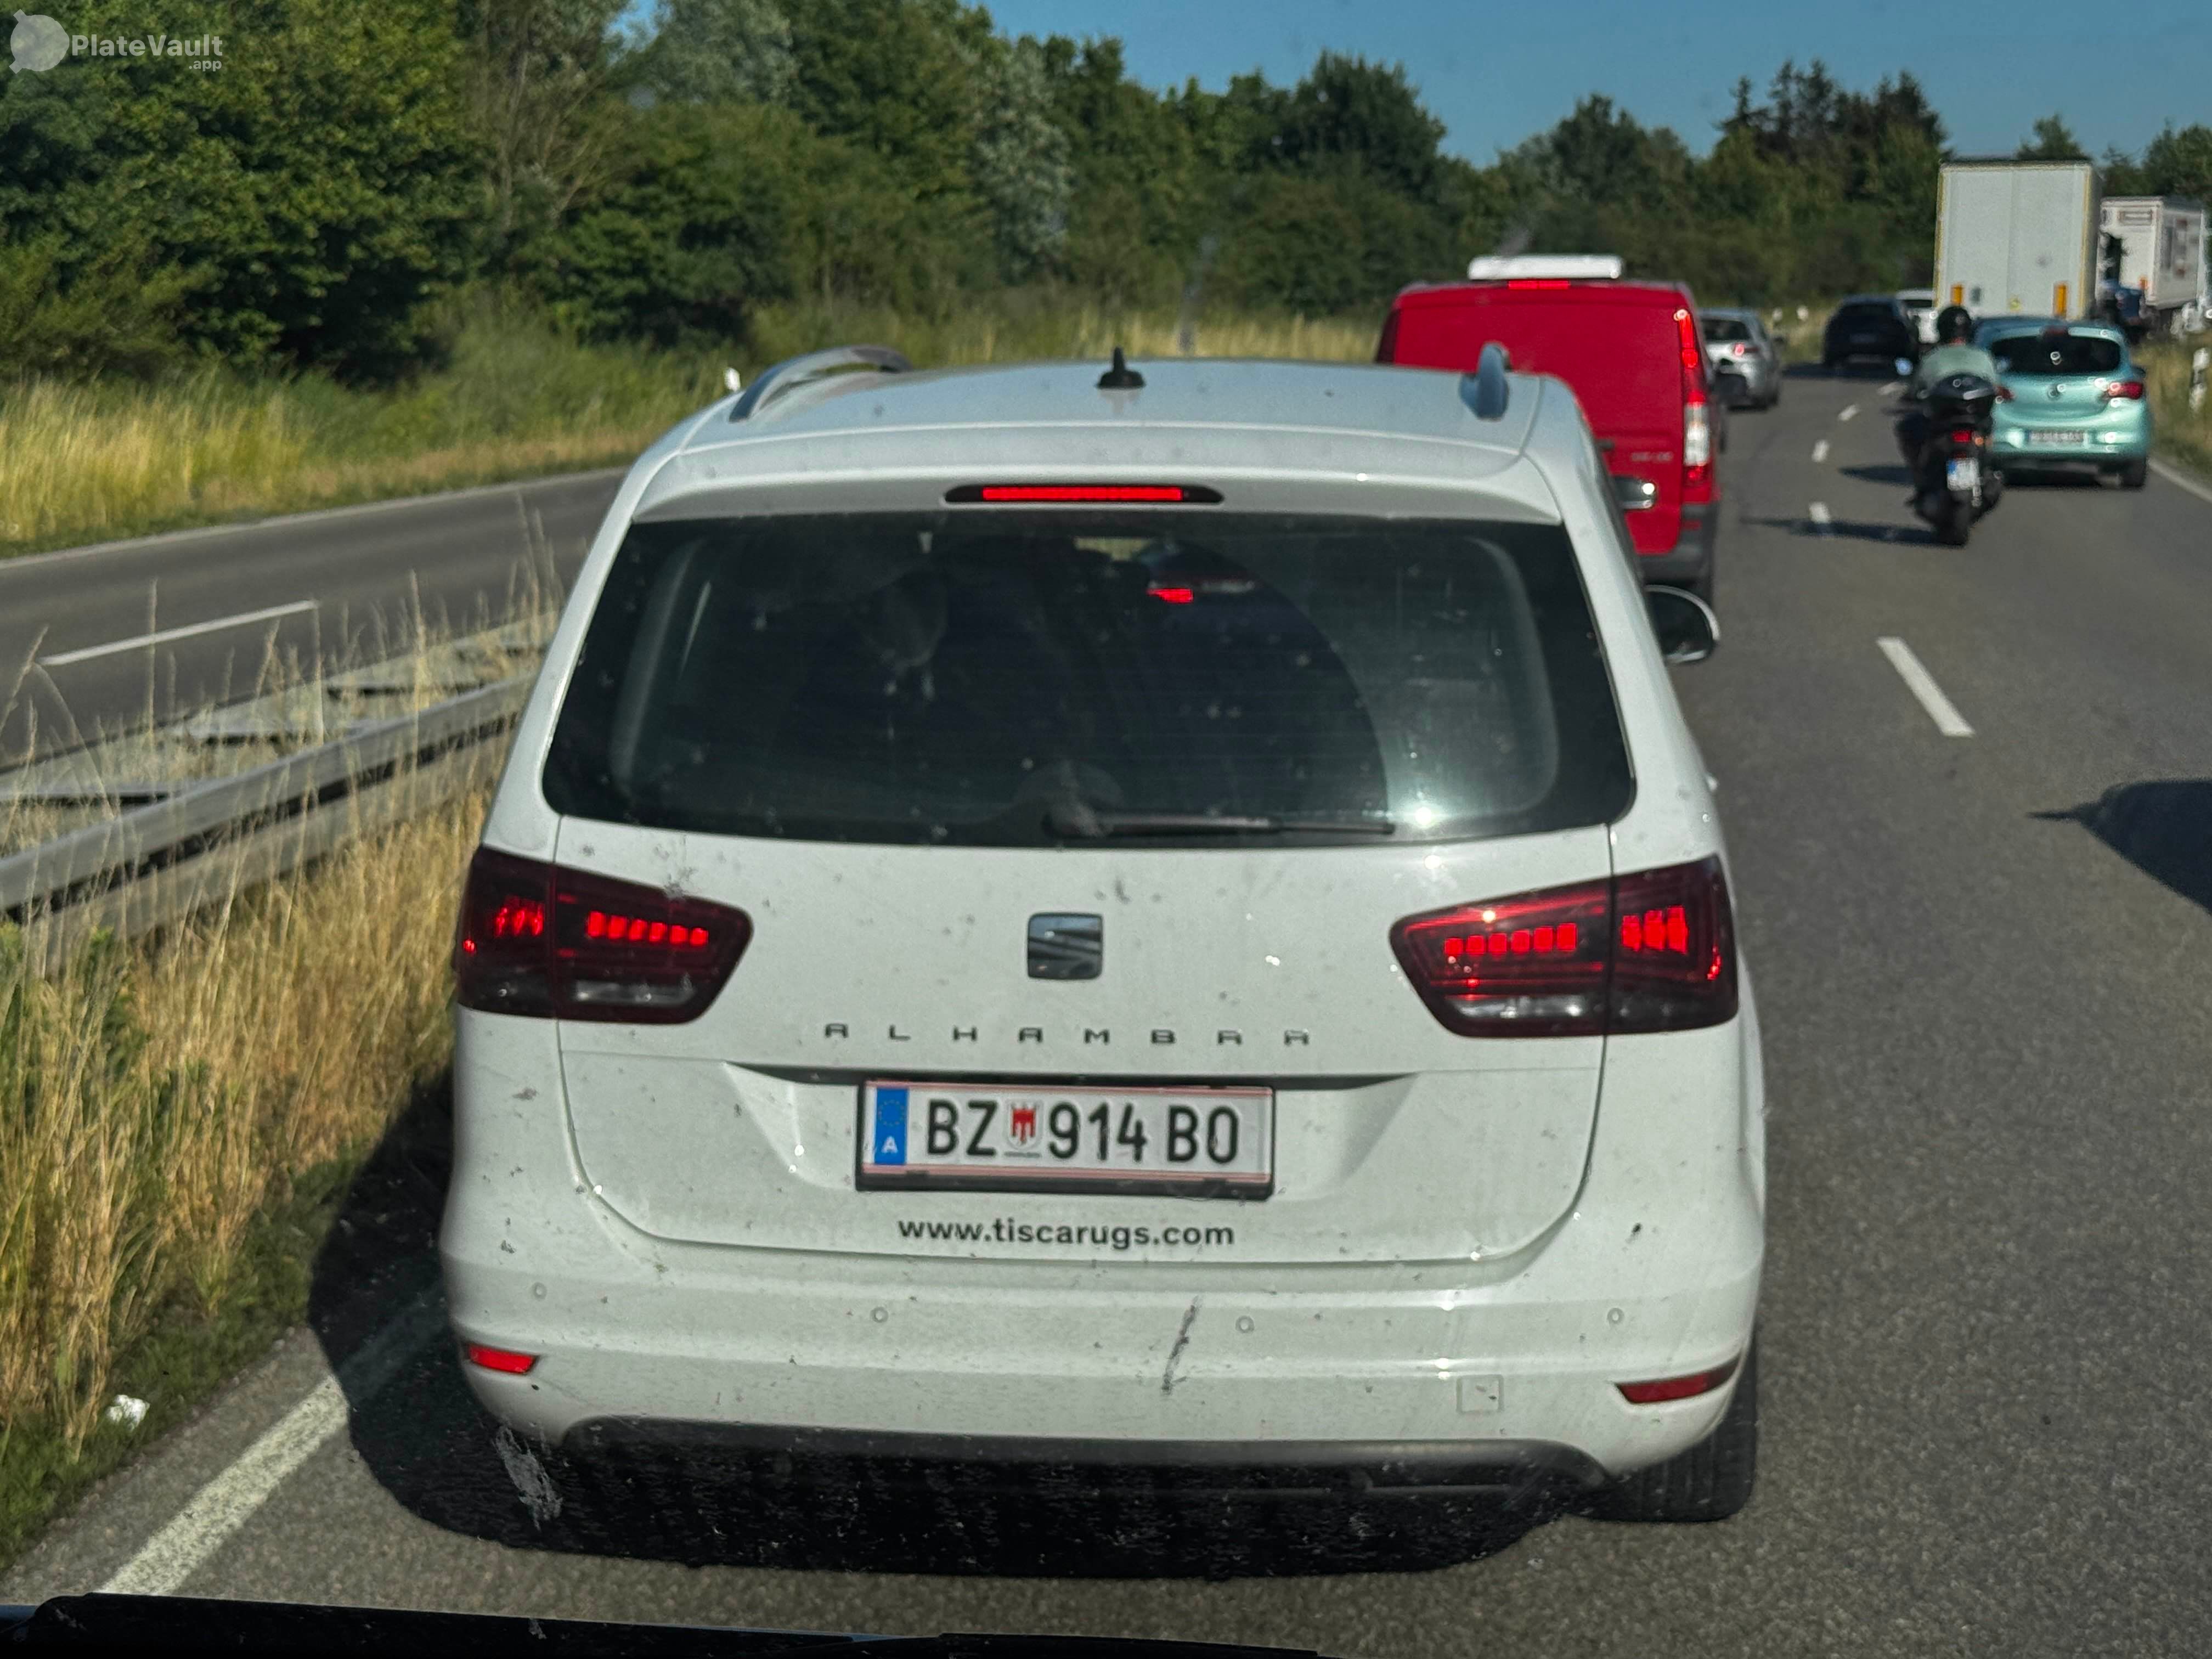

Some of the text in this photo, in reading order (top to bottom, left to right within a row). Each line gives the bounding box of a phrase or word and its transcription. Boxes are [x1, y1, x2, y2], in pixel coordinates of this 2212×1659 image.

[824, 1023, 1310, 1046] ALHAMBRA
[927, 1099, 998, 1156] BZ
[1048, 1102, 1147, 1161] 914
[881, 1136, 898, 1153] A
[898, 1217, 1235, 1250] www.tiscarugs.com
